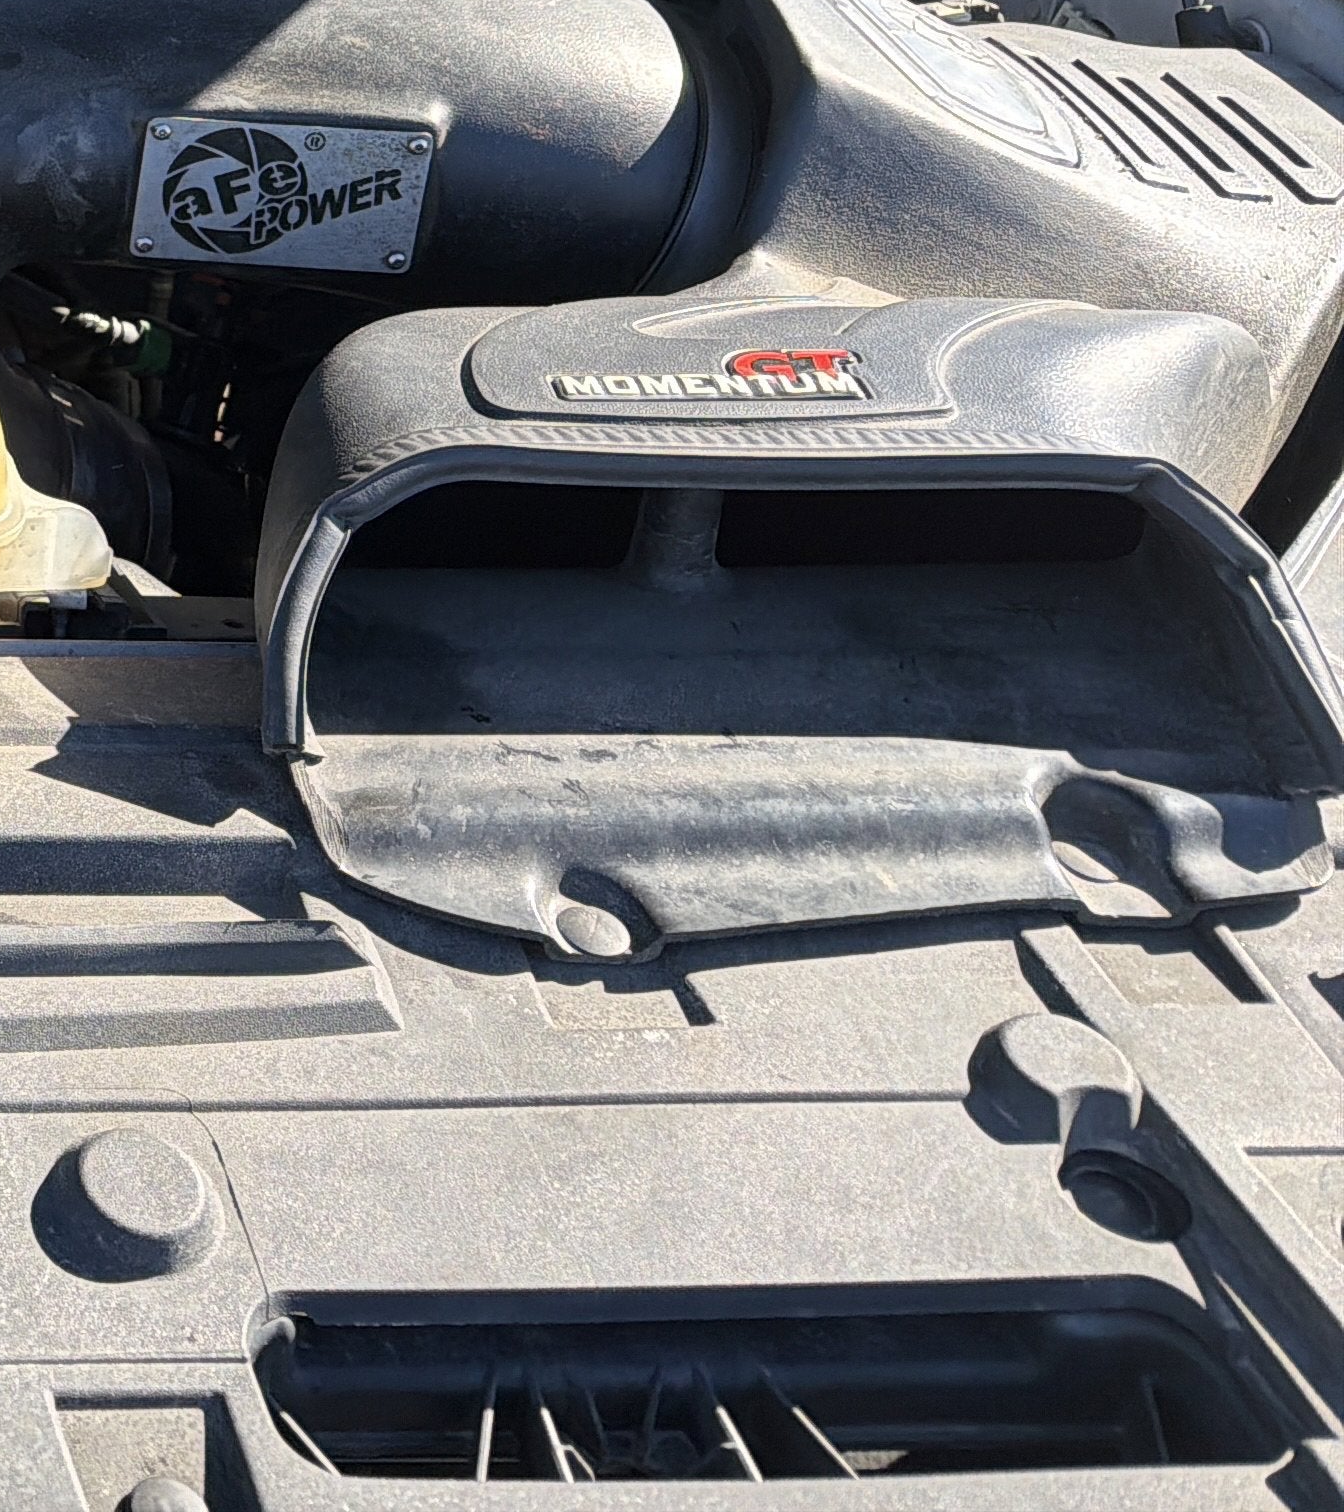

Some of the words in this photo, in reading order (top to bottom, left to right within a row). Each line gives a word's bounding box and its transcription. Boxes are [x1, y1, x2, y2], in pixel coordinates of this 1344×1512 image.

[249, 168, 403, 244] POWER
[733, 349, 851, 382] GT
[562, 371, 864, 398] MOMENTUM
